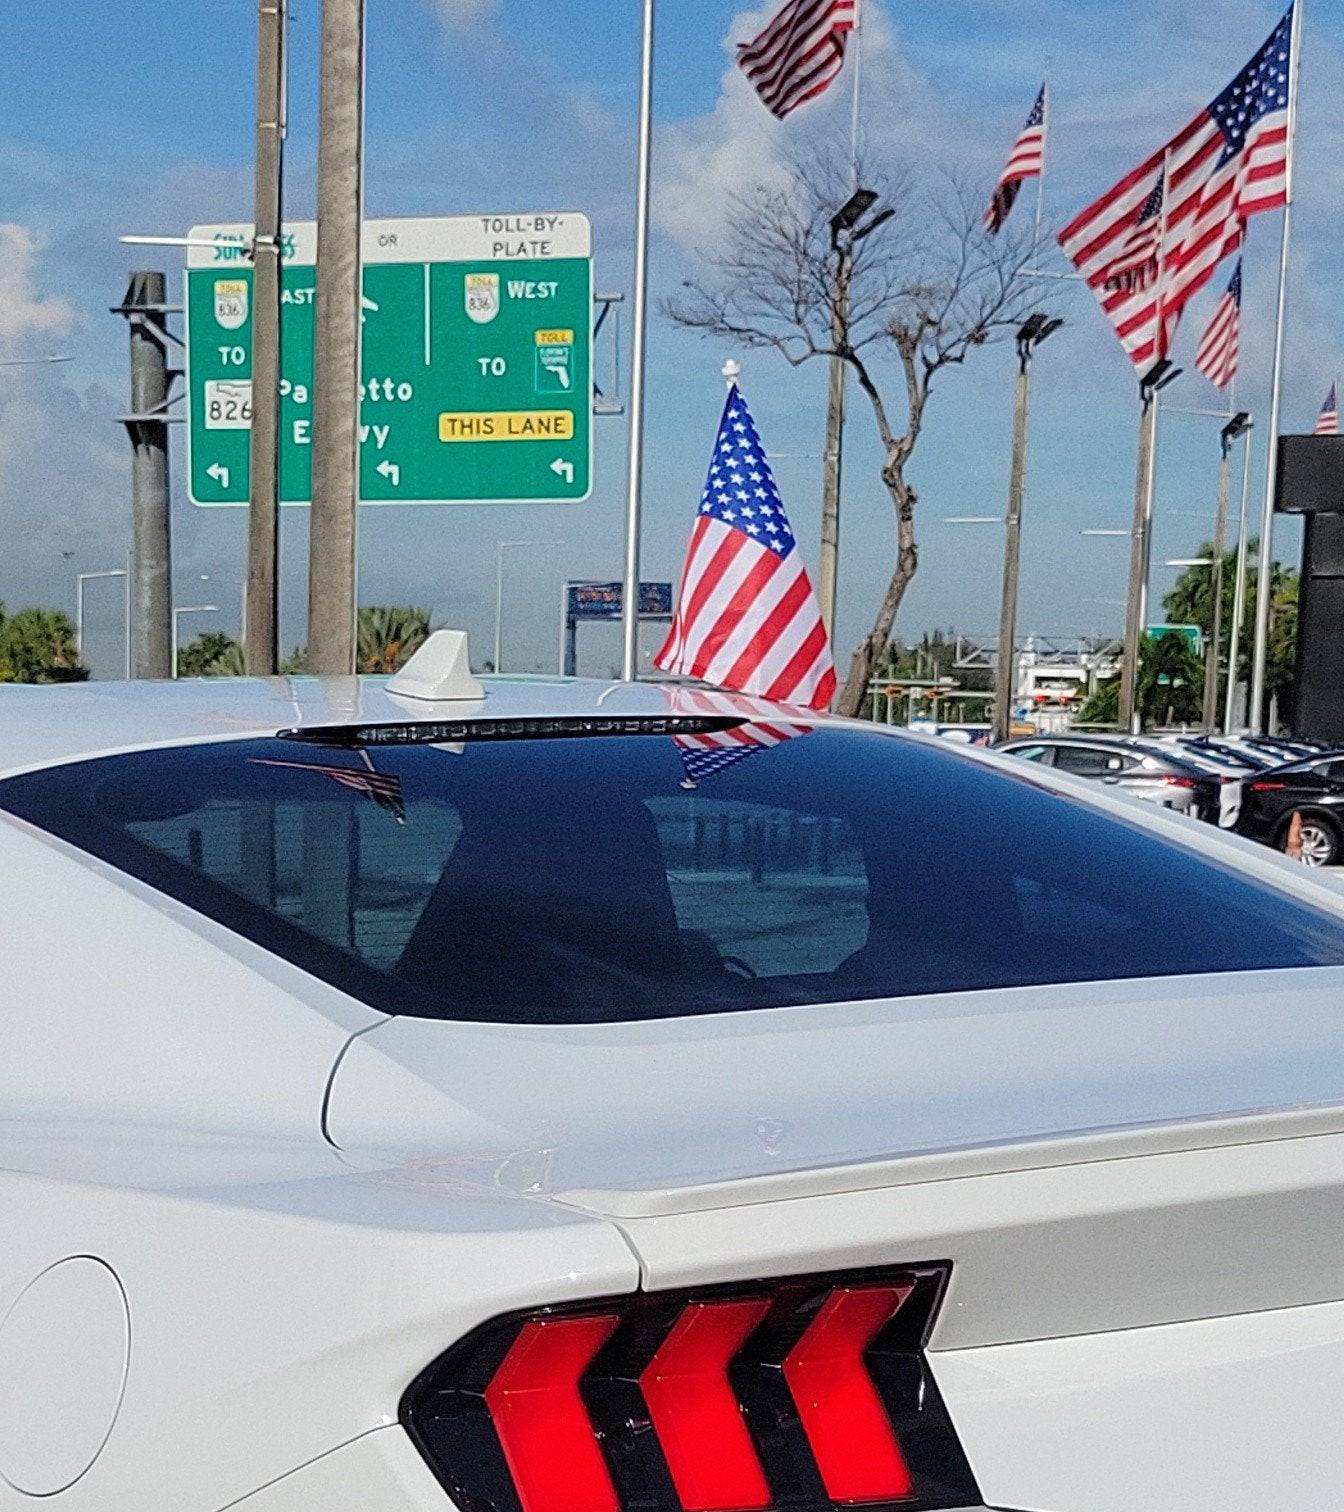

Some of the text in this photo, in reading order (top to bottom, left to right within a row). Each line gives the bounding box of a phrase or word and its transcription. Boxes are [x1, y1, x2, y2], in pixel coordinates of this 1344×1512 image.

[481, 217, 564, 234] TOLL-BY-
[377, 234, 398, 247] OR
[492, 241, 551, 257] PLATE
[281, 288, 316, 304] AST
[507, 280, 559, 299] WEST
[469, 297, 490, 311] 836
[540, 332, 568, 343] TOLL
[218, 346, 246, 366] TO
[477, 357, 506, 376] TO
[209, 400, 254, 421] 826
[447, 416, 566, 436] THIS LANE
